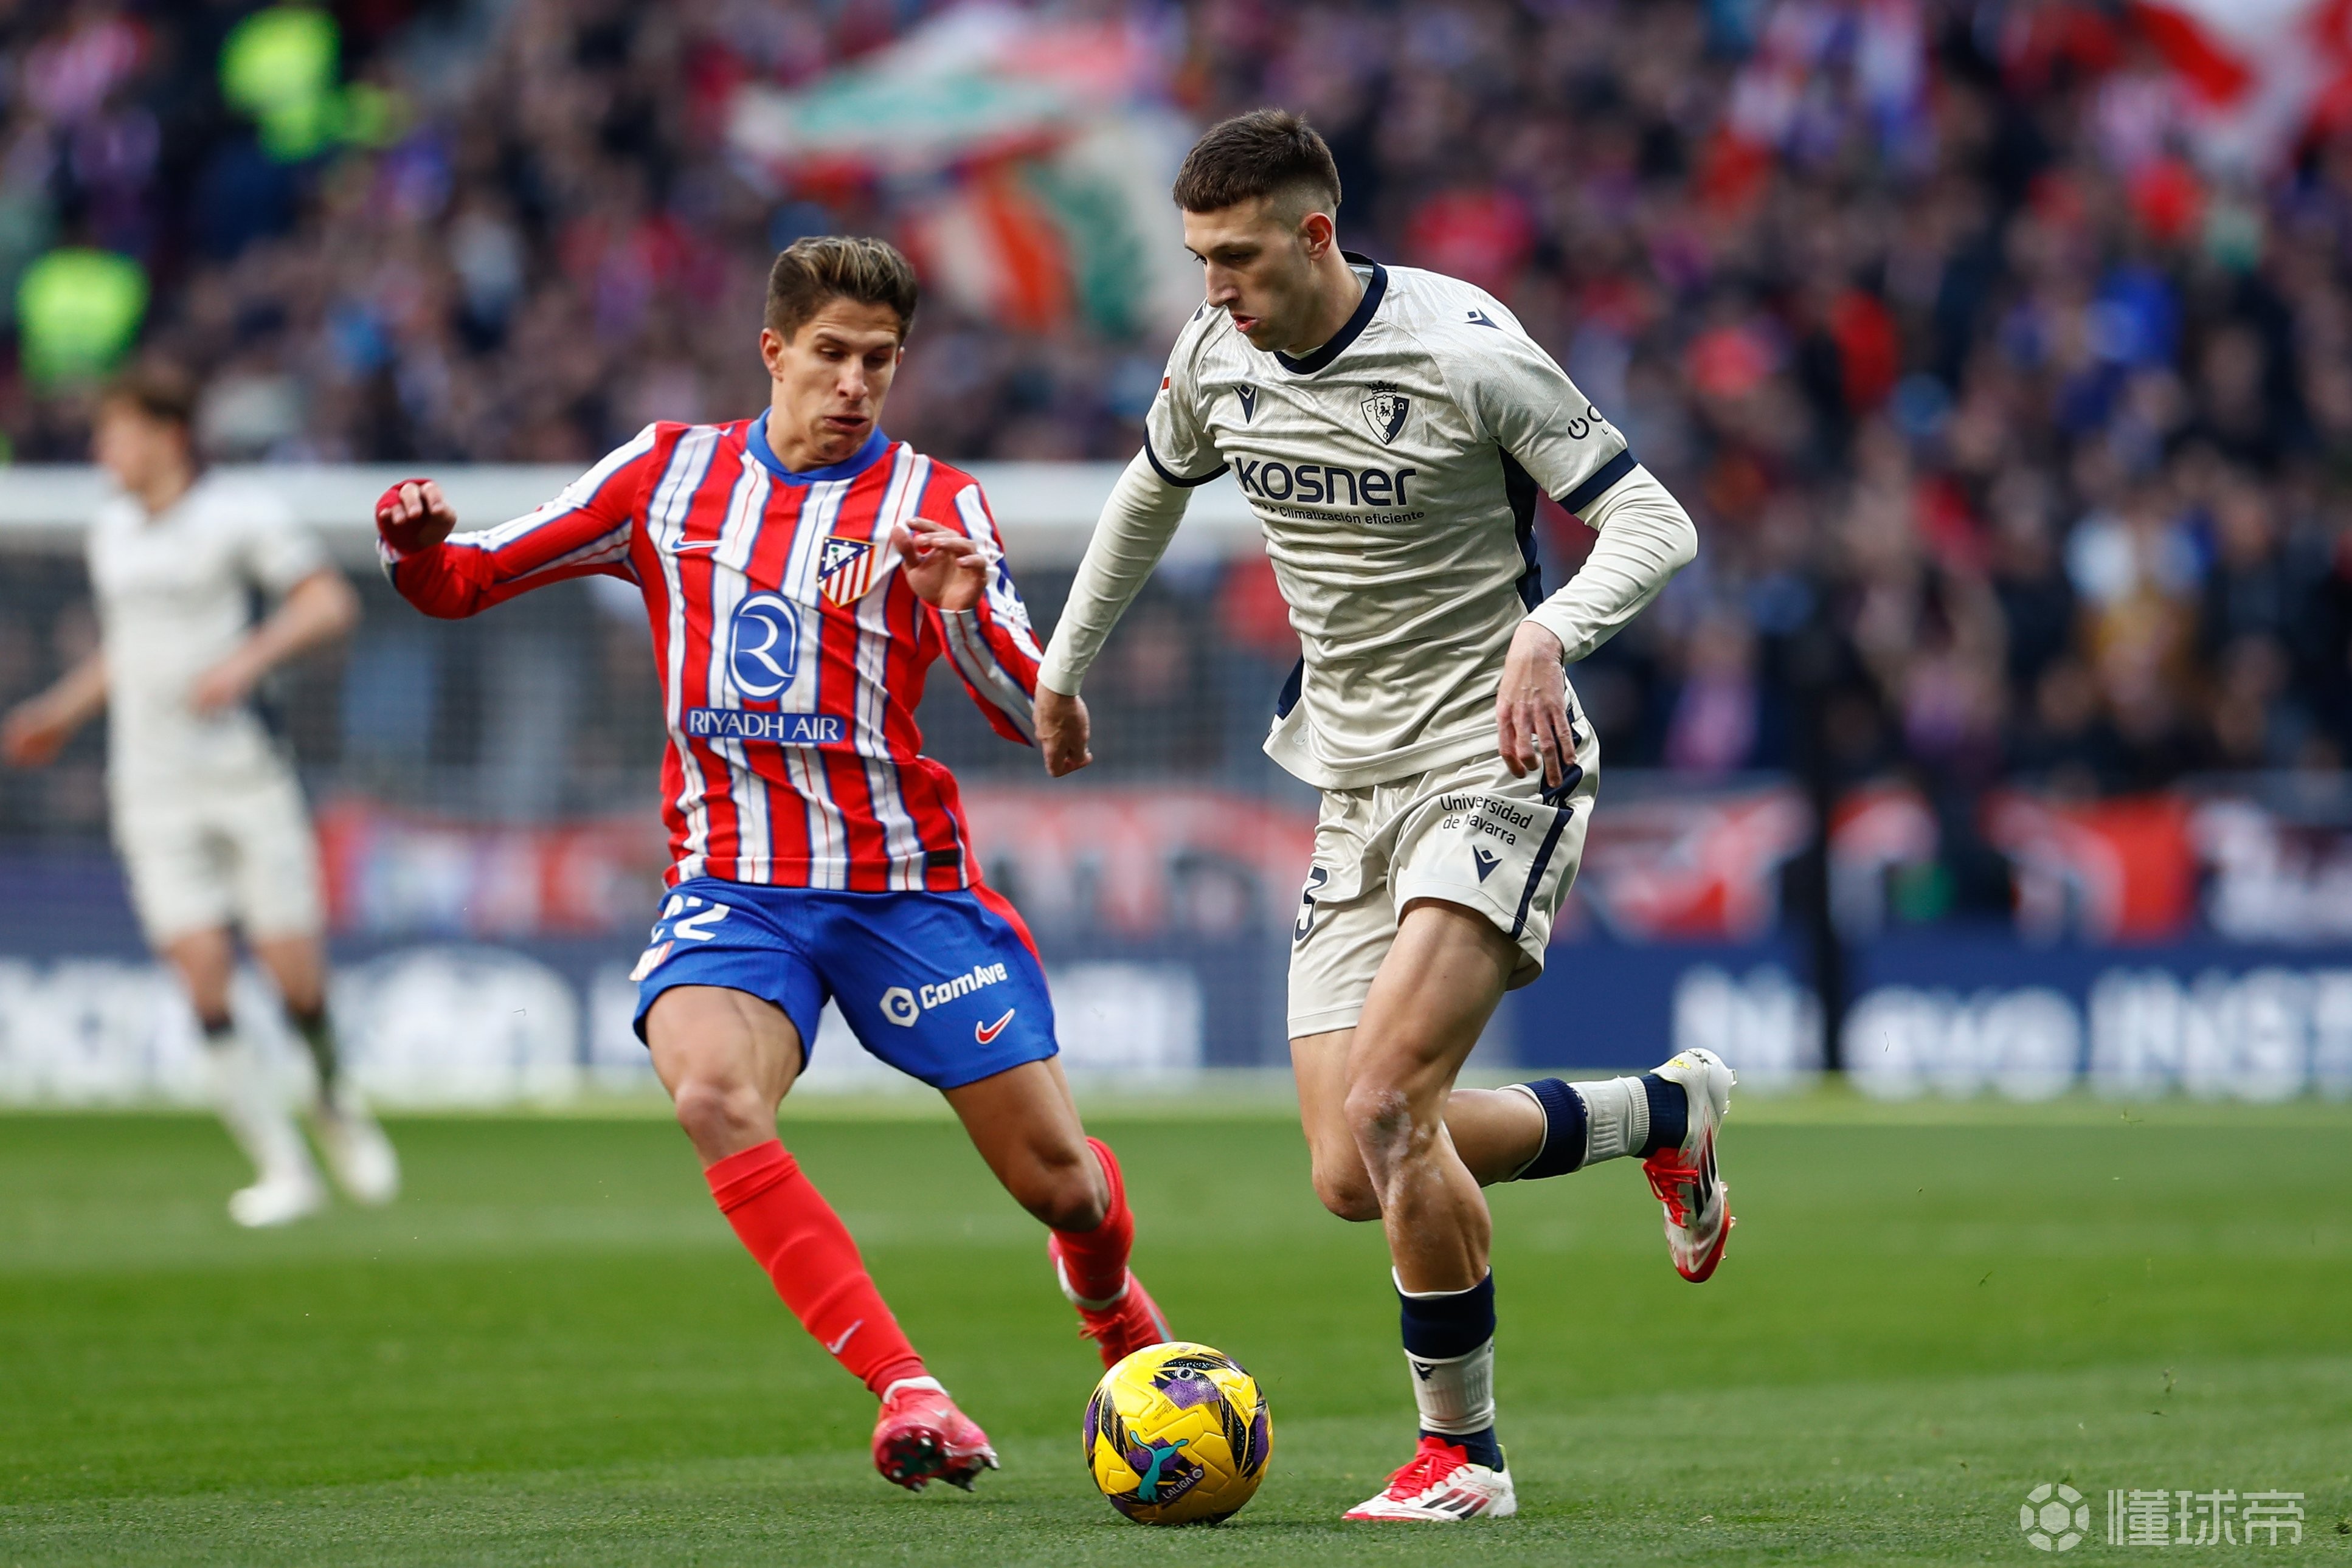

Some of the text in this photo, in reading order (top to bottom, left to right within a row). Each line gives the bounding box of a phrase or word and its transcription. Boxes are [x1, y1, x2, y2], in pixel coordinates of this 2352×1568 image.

[1279, 506, 1425, 524] Climatización eficiente
[690, 711, 839, 741] RIYADH AIR
[1441, 793, 1534, 830] Universidad
[1443, 814, 1460, 829] de
[919, 962, 1008, 1009] ComAve
[1161, 1477, 1194, 1499] LALIGA
